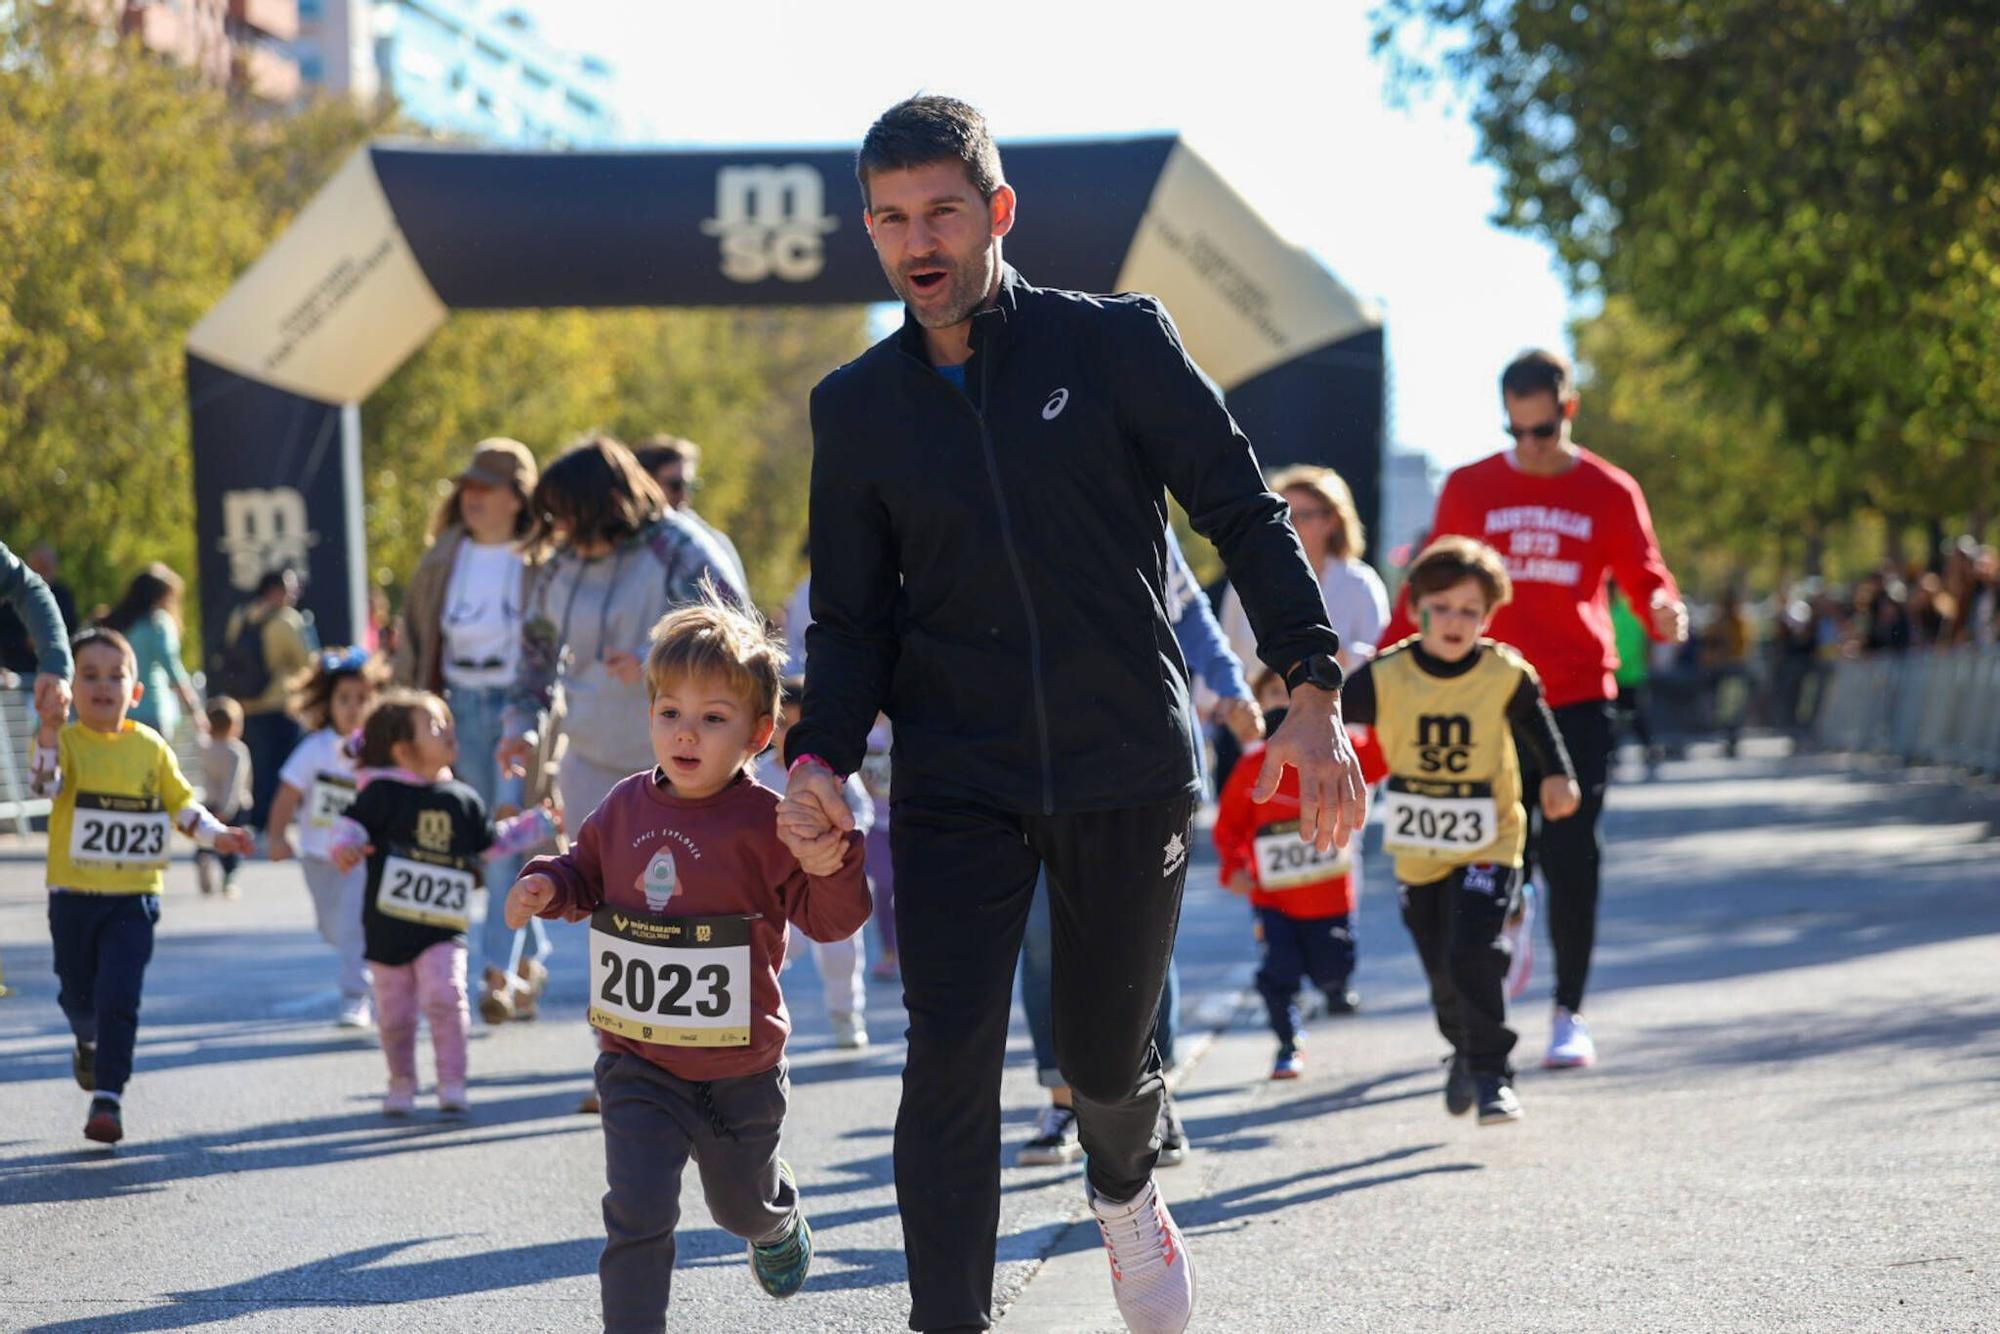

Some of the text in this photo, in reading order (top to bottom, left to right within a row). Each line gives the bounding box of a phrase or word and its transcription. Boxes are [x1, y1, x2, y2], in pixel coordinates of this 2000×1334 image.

[1484, 505, 1592, 541] AUSTRALIA
[82, 818, 164, 855] 2023
[1397, 805, 1483, 843] 2023
[392, 868, 467, 911] 2023
[601, 950, 731, 1018] 2023
